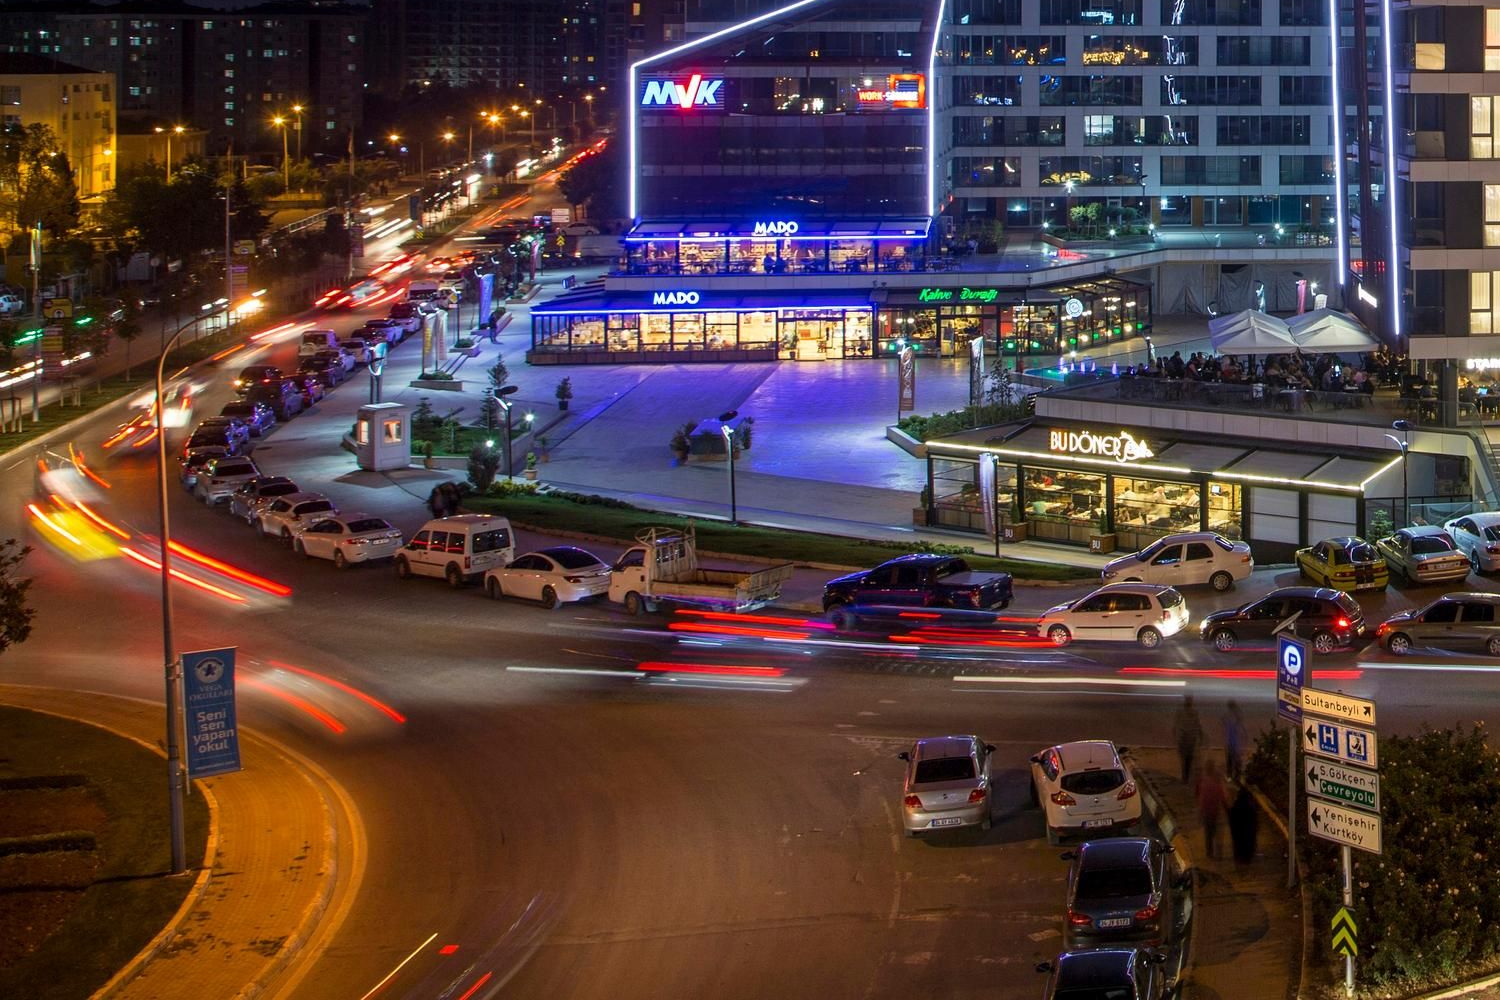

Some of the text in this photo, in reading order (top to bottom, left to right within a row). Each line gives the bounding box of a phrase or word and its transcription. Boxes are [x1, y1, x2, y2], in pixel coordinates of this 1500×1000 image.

[641, 74, 724, 109] MVK
[754, 220, 799, 234] MADO
[653, 291, 700, 305] MADO
[919, 287, 998, 303] Kahve Durağı
[1050, 430, 1122, 457] BU DÖNER
[1005, 528, 1013, 538] BU
[1092, 539, 1101, 549] BU
[1304, 694, 1360, 716] Sultanbeyli
[197, 709, 227, 723] Seni
[199, 720, 226, 732] sen
[193, 728, 235, 746] yapan
[198, 740, 230, 753] okul
[1320, 765, 1366, 787] S.Gökçen
[1320, 781, 1375, 804] Çevreyolu
[1323, 807, 1376, 831] Yenişehir
[1323, 822, 1364, 845] Kurtköy
